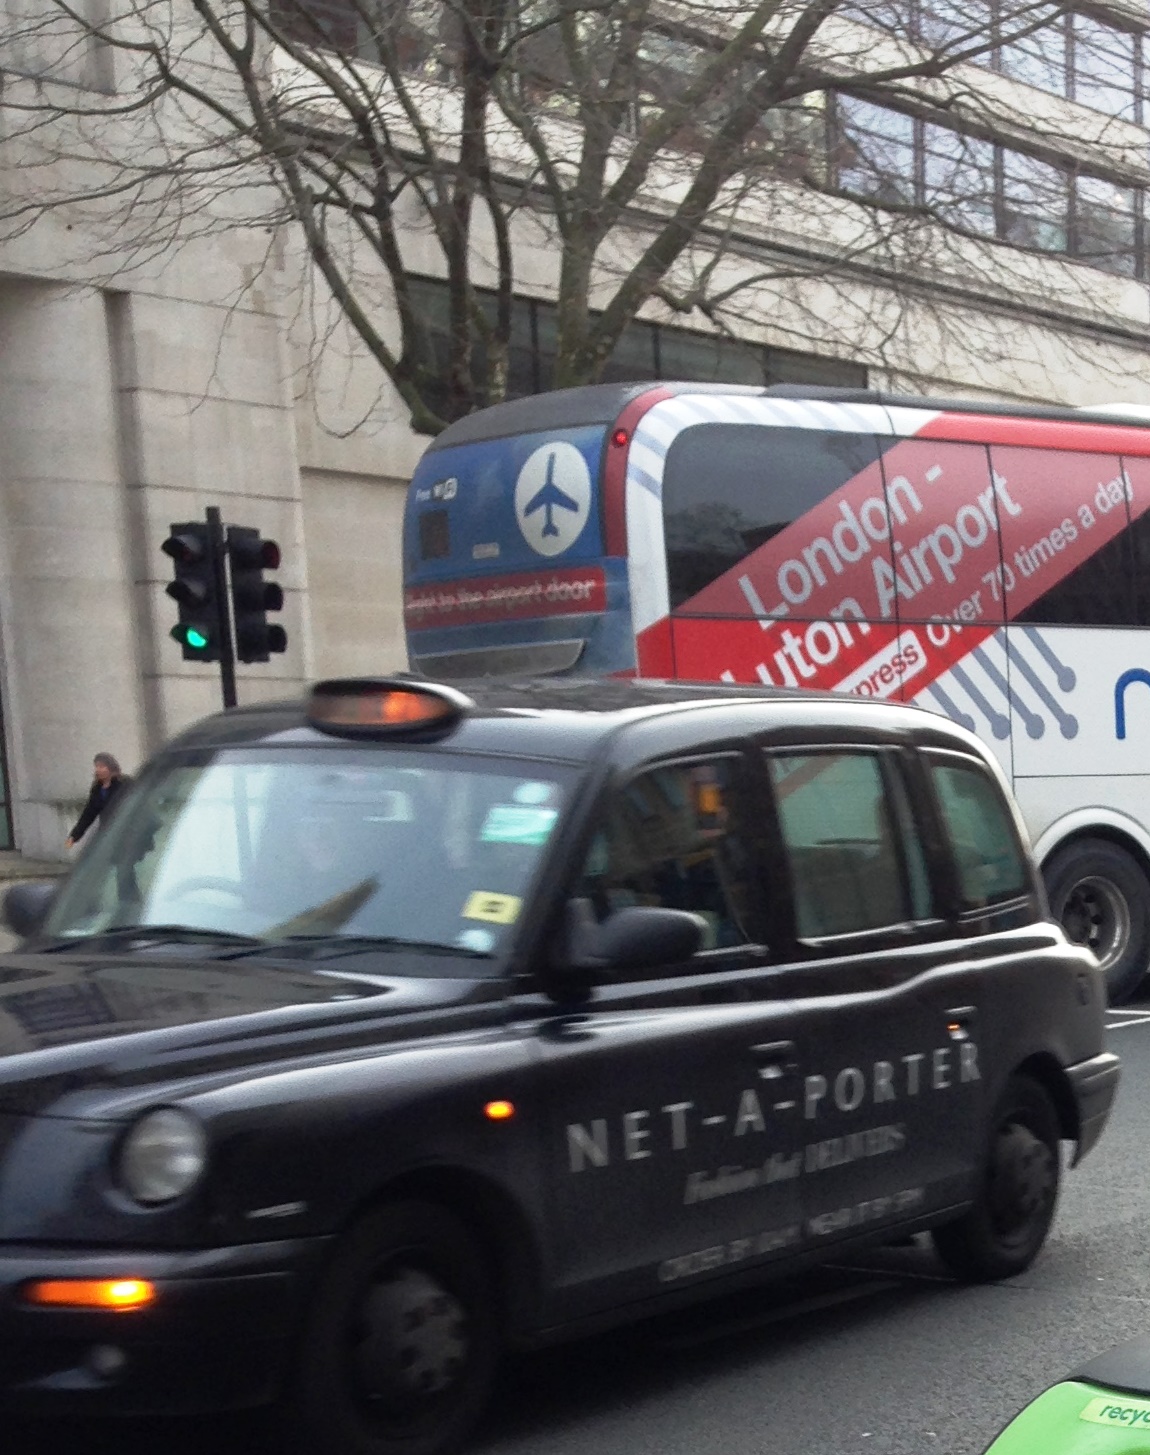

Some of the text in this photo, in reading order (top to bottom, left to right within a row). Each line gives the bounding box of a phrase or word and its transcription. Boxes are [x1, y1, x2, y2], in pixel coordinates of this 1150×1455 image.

[545, 576, 596, 603] door
[720, 469, 1022, 688] uton Airport
[738, 473, 923, 630] London
[926, 591, 984, 648] Over
[982, 562, 1016, 602] 70
[1014, 518, 1078, 580] times
[1080, 504, 1096, 530] a
[1094, 470, 1135, 513] day
[566, 1042, 982, 1173] NET-A-PORTER
